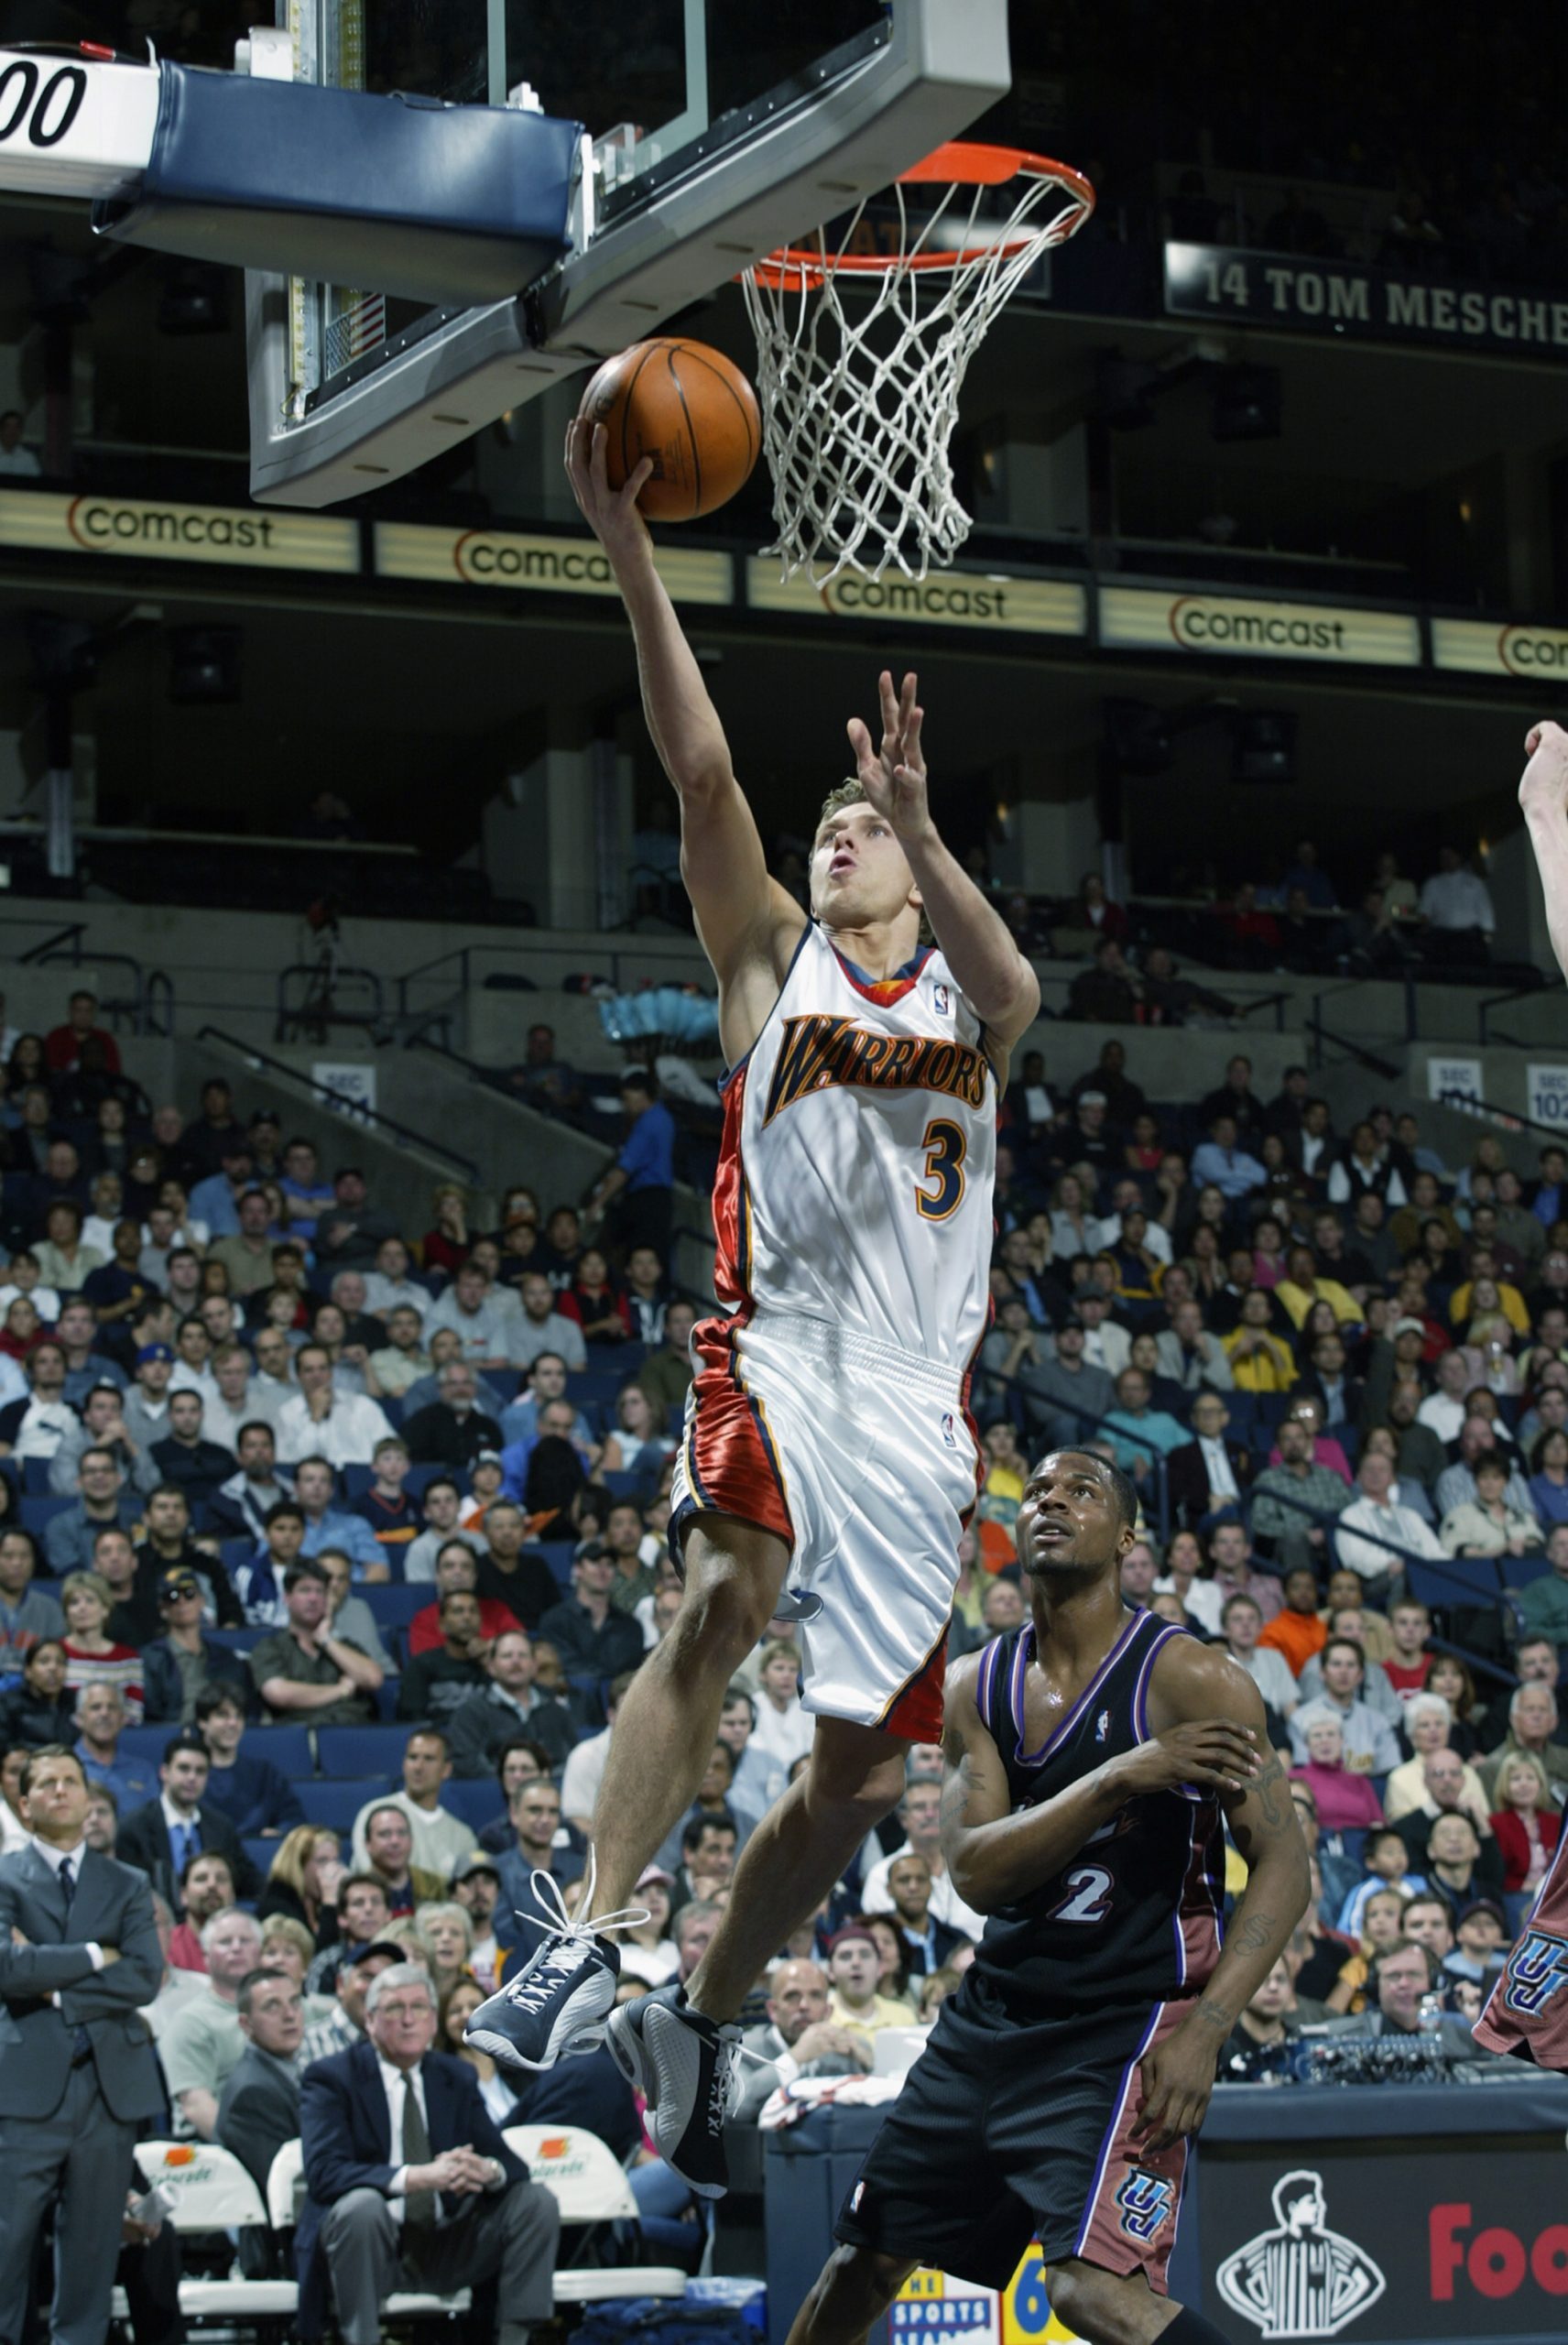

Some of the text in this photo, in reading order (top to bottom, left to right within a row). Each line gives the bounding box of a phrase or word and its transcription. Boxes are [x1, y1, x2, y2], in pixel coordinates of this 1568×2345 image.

[0, 60, 87, 147] 00
[1203, 261, 1568, 345] 14 TOM MESCHE
[84, 507, 275, 549] comcast
[470, 544, 612, 583] comca
[837, 579, 1007, 620] comcast
[1183, 611, 1345, 650] comcast
[761, 1014, 989, 1131] WARRIORS
[915, 1118, 966, 1221] 3
[1047, 1863, 1115, 1924] 2
[901, 2276, 935, 2294] HE
[894, 2300, 985, 2326] SPORTS
